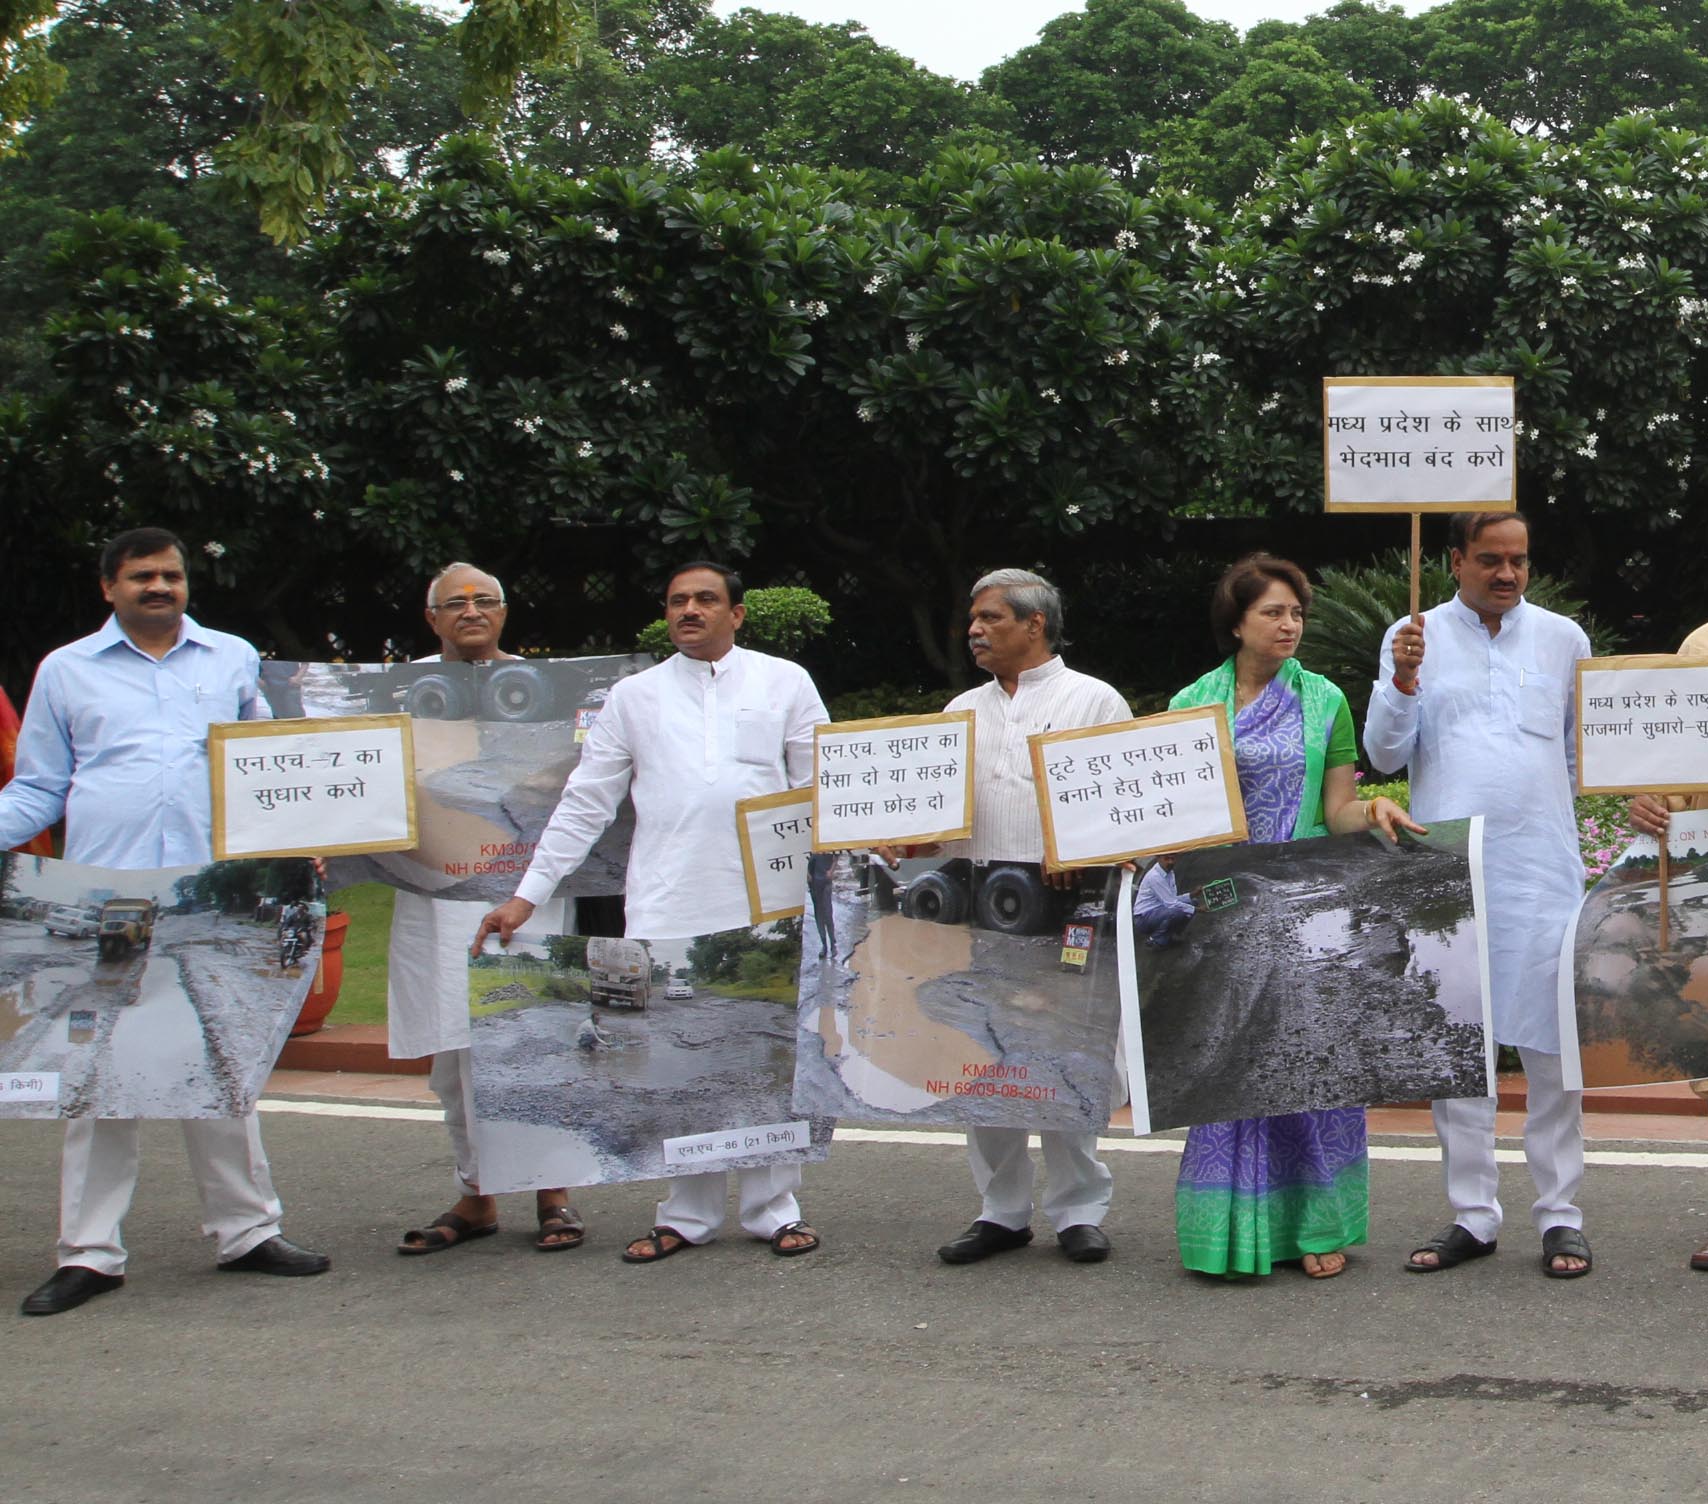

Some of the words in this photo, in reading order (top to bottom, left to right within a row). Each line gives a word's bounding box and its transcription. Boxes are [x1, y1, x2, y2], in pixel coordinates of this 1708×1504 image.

[1328, 415, 1367, 433] मध्य
[1378, 409, 1430, 433] प्रदेश
[1442, 409, 1462, 433] के
[1339, 444, 1412, 468] भेदभाव
[1424, 446, 1454, 468] बंद
[1466, 444, 1504, 467] करो
[1588, 696, 1613, 710] मध्य
[1621, 690, 1656, 709] प्रदेश
[1663, 689, 1679, 707] के
[1582, 718, 1632, 736] राजमार्ग
[355, 749, 382, 764] का
[821, 741, 876, 761] एन.एच.
[886, 736, 929, 758] सुधार
[938, 733, 959, 748] का
[1047, 755, 1075, 781] टूटे
[1086, 753, 1112, 776] हुए
[1122, 743, 1183, 766] एन.एच.
[1192, 732, 1216, 753] को
[820, 770, 852, 789] पैसा
[861, 766, 879, 786] दो
[888, 768, 906, 783] या
[916, 758, 958, 782] सड़के
[1056, 781, 1103, 804] बनाने
[1112, 776, 1144, 798] हेतु
[1150, 770, 1186, 789] पैसा
[1195, 761, 1215, 781] दो
[254, 786, 312, 810] सुधार
[325, 777, 366, 799] करो
[832, 801, 875, 818] वापस
[884, 793, 917, 815] छोड़
[926, 791, 944, 810] दो
[1108, 807, 1144, 825] पैसा
[1153, 798, 1175, 817] दो
[480, 843, 537, 856] KM30/1
[445, 863, 468, 875] NH
[474, 860, 530, 874] 69/09-0
[768, 854, 794, 872] का
[962, 1063, 1028, 1080] KM30/10
[926, 1079, 949, 1094] NH
[954, 1081, 1057, 1101] 69/09-08-2011
[744, 1136, 760, 1149] (21
